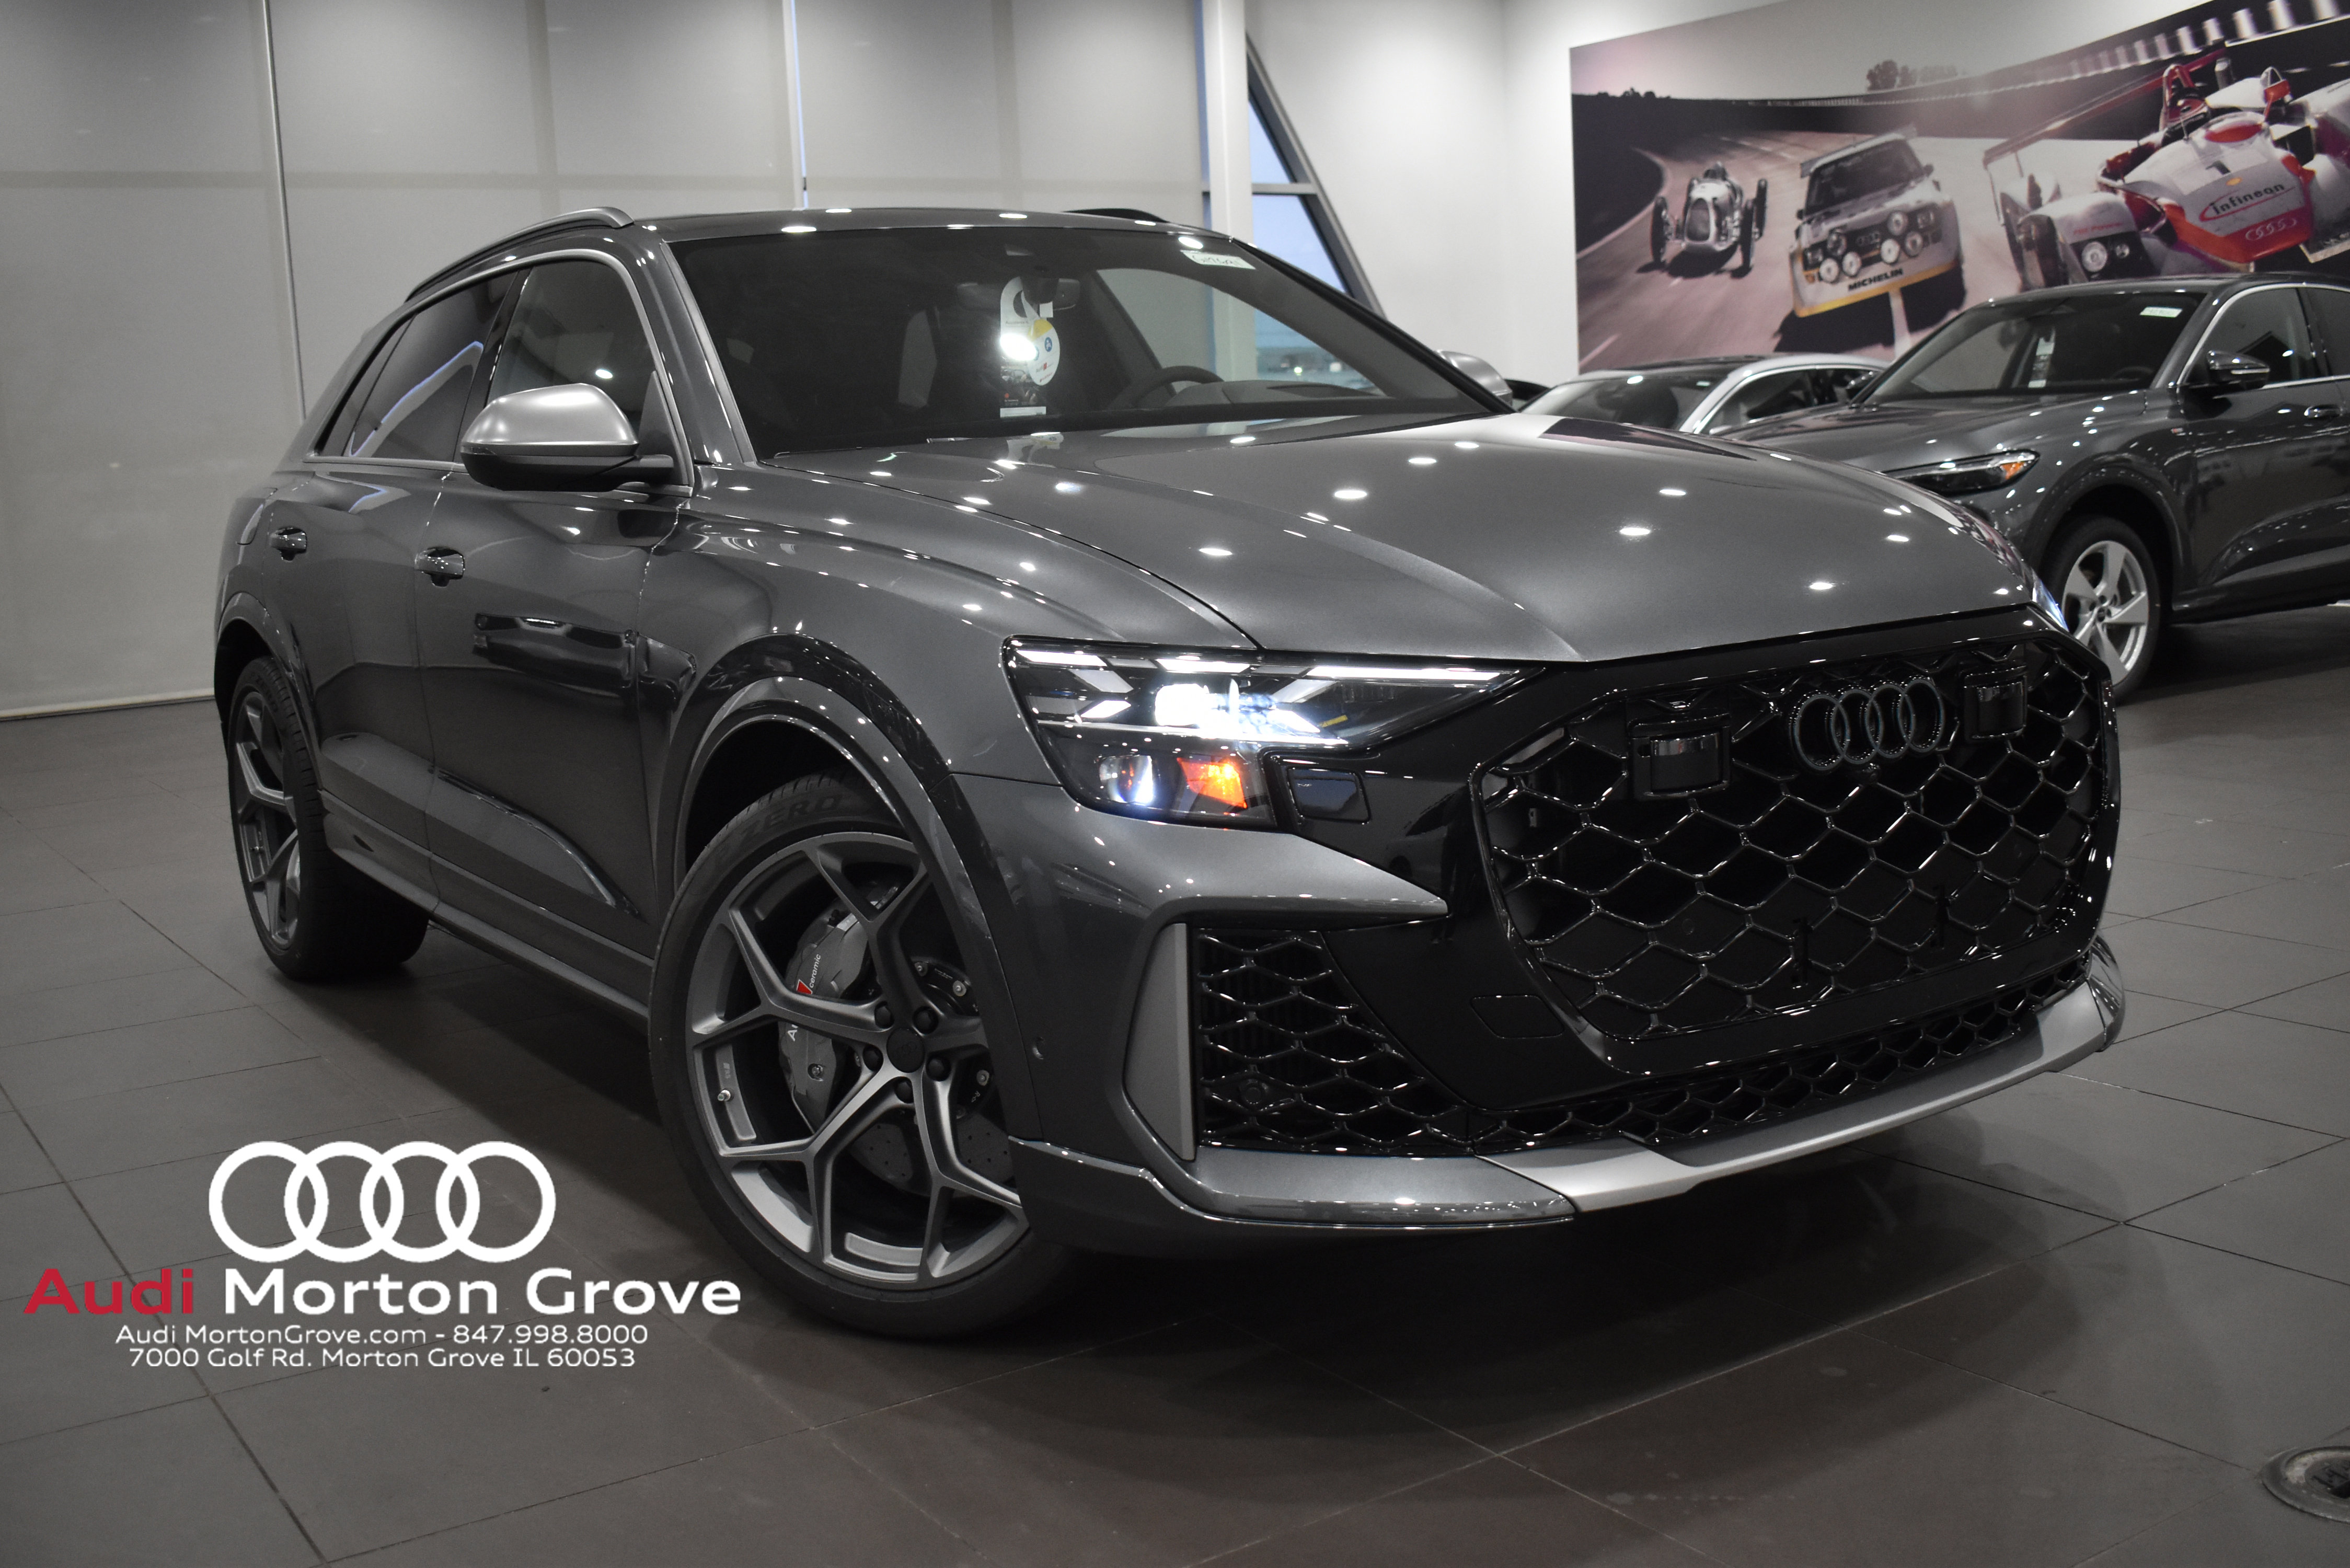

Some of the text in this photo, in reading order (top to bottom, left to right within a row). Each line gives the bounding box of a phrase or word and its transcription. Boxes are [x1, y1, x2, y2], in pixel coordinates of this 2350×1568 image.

[2209, 183, 2285, 215] Infineon
[1848, 268, 1904, 291] MICHELIN
[810, 954, 821, 988] ceramic
